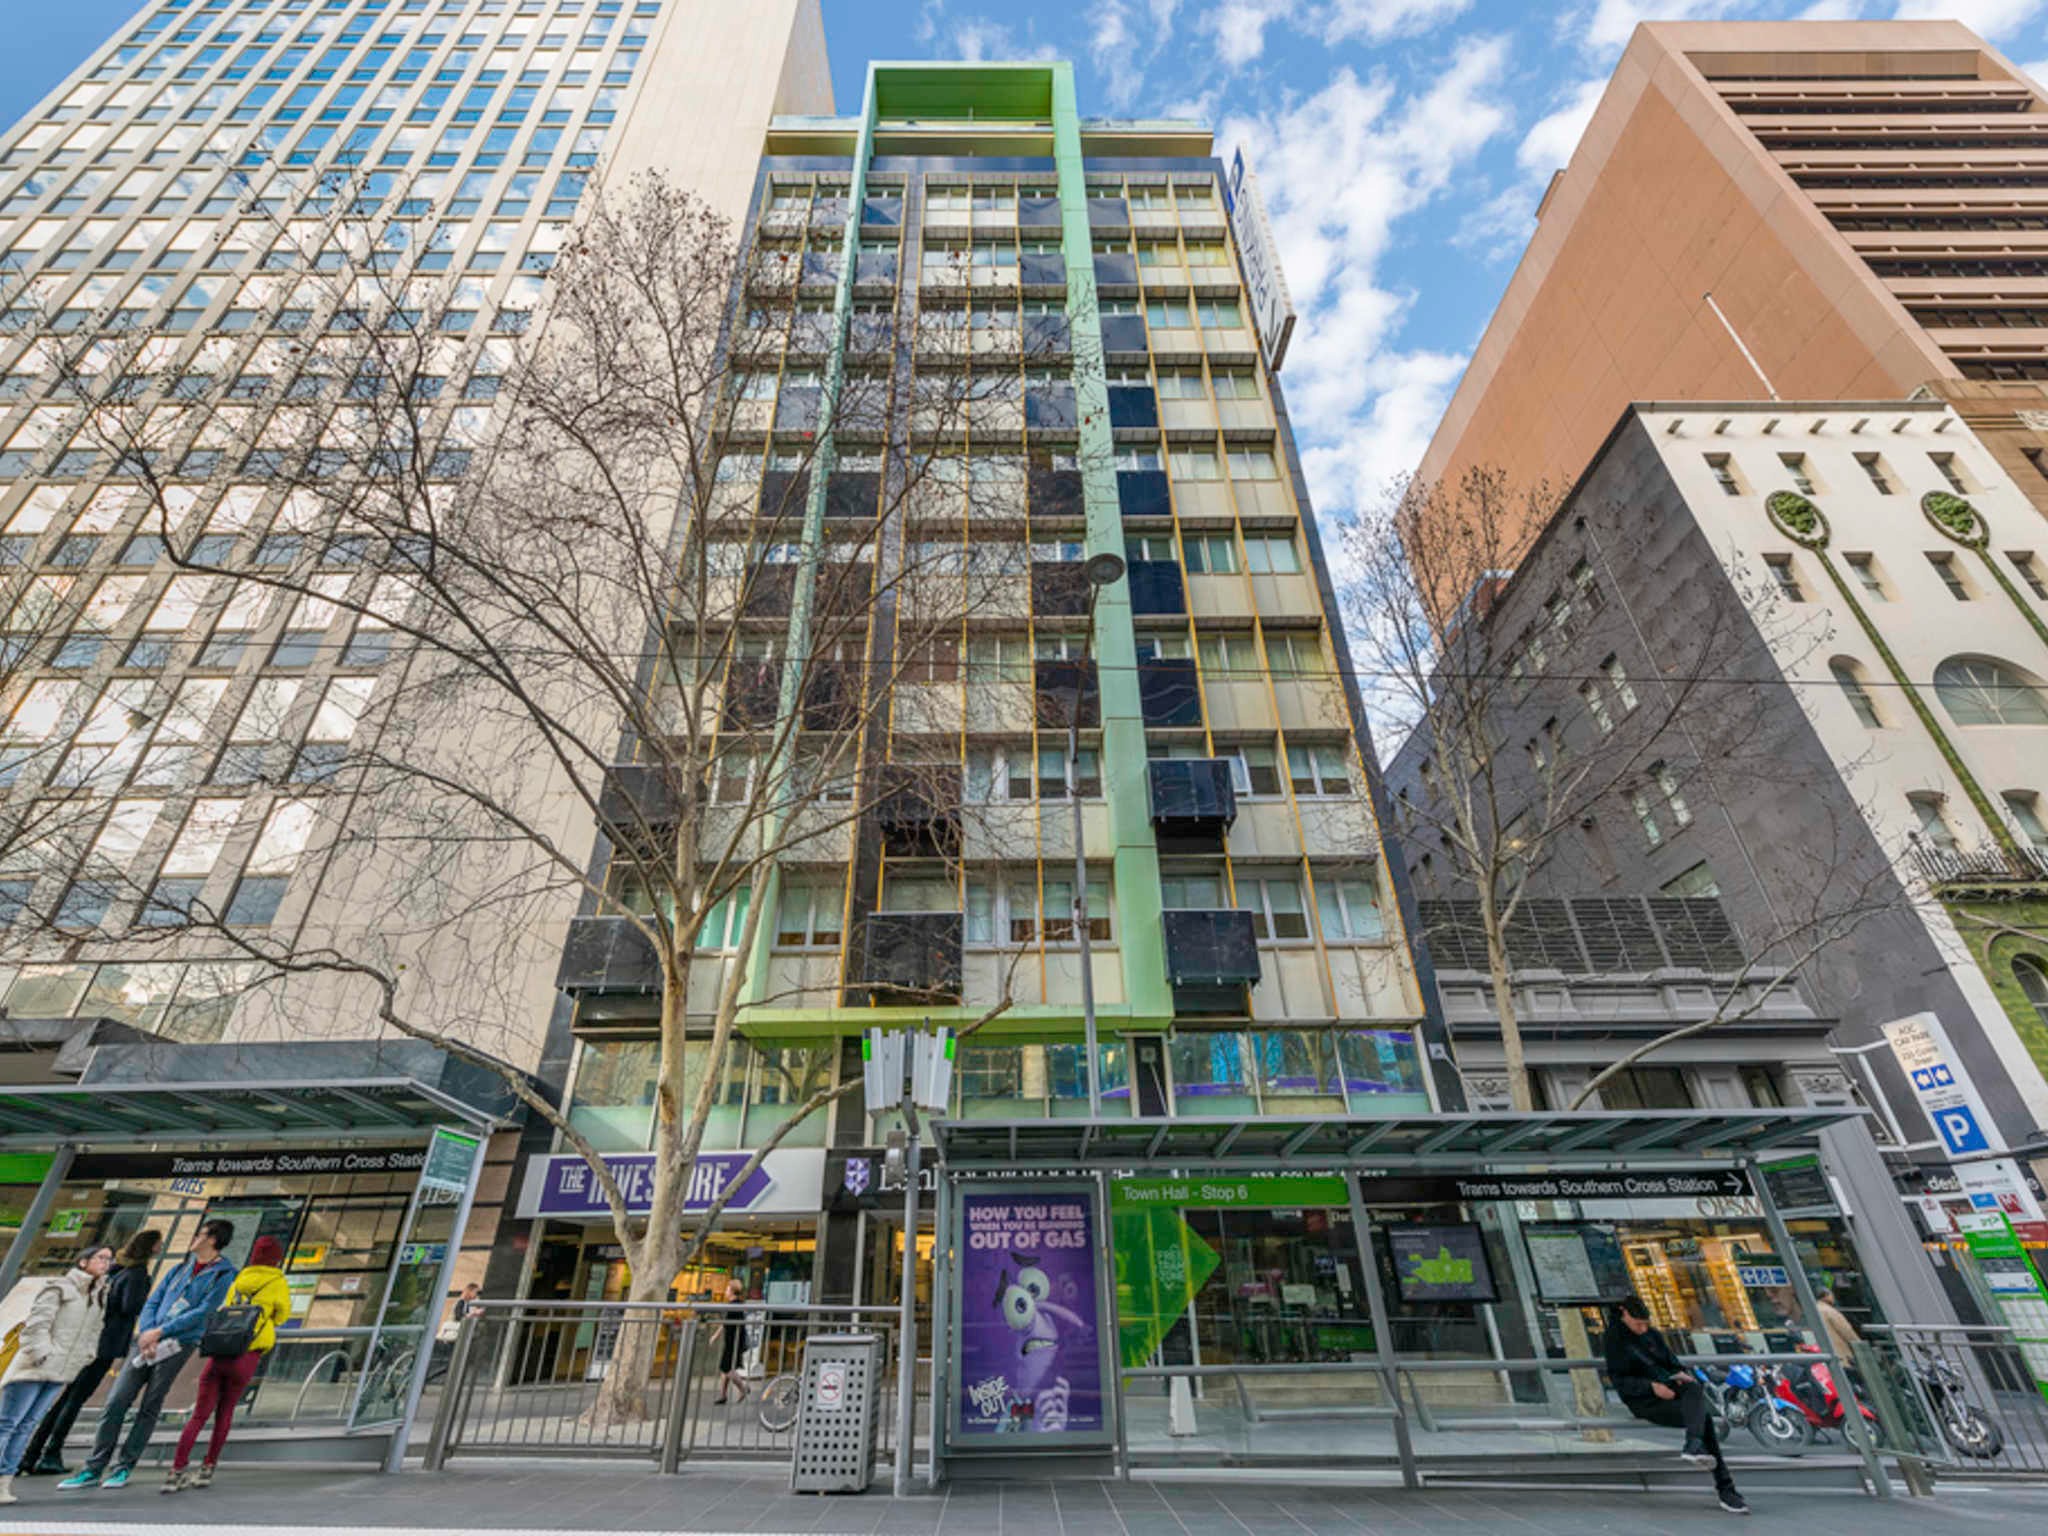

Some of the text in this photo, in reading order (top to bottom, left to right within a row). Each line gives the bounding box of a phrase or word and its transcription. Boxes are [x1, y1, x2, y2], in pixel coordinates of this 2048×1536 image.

[1944, 1114, 1970, 1148] P
[171, 1152, 427, 1173] Trams towards Southern Cross Statio
[559, 1165, 586, 1189] THE
[1456, 1177, 1718, 1197] Trams towards Southern Cross Station
[1122, 1186, 1159, 1201] Town
[1162, 1186, 1189, 1200] Hall
[1202, 1184, 1236, 1202] Stop
[1238, 1185, 1249, 1199] 6
[969, 1204, 1084, 1221] HOW YOU FEEL
[969, 1222, 1001, 1231] WHEN
[1038, 1220, 1085, 1230] RUNNING
[969, 1230, 1086, 1249] OUT OF GAS
[981, 1394, 1007, 1417] OUT
